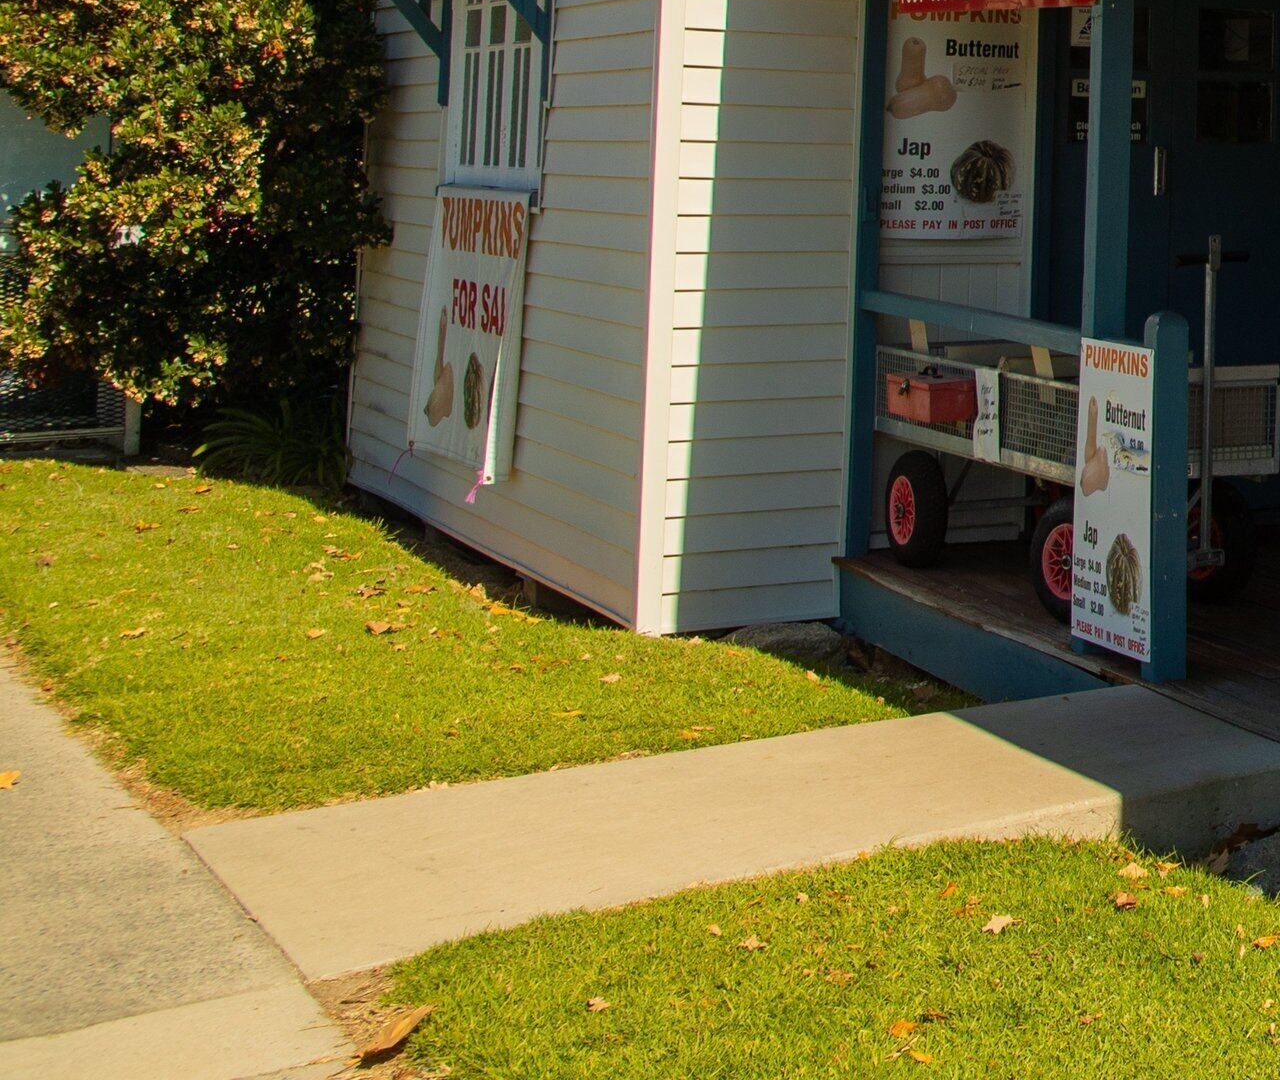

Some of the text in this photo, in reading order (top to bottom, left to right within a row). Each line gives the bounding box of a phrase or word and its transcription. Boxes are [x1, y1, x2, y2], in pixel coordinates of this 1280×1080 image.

[946, 39, 1019, 58] Butternut
[898, 138, 931, 159] Jap
[881, 168, 939, 179] arge $4.00
[921, 184, 950, 195] $3.00
[880, 200, 944, 211] mall $2.00
[442, 196, 524, 260] PUMPKINS
[880, 219, 1017, 229] PLEASE PAY IN POST OFFICE
[451, 278, 477, 329] FOR
[1085, 344, 1149, 378] PUMPKINS
[1106, 400, 1145, 431] Butternut
[1083, 520, 1097, 549] Jap
[1073, 552, 1101, 574] Large $4.00
[1073, 573, 1107, 597] Medium $3.00
[1073, 593, 1104, 617] Small $2.00
[1076, 619, 1092, 636] PLEASE
[1094, 626, 1104, 639] PAY
[1113, 633, 1125, 648] POST
[1128, 638, 1145, 656] OFFICE
